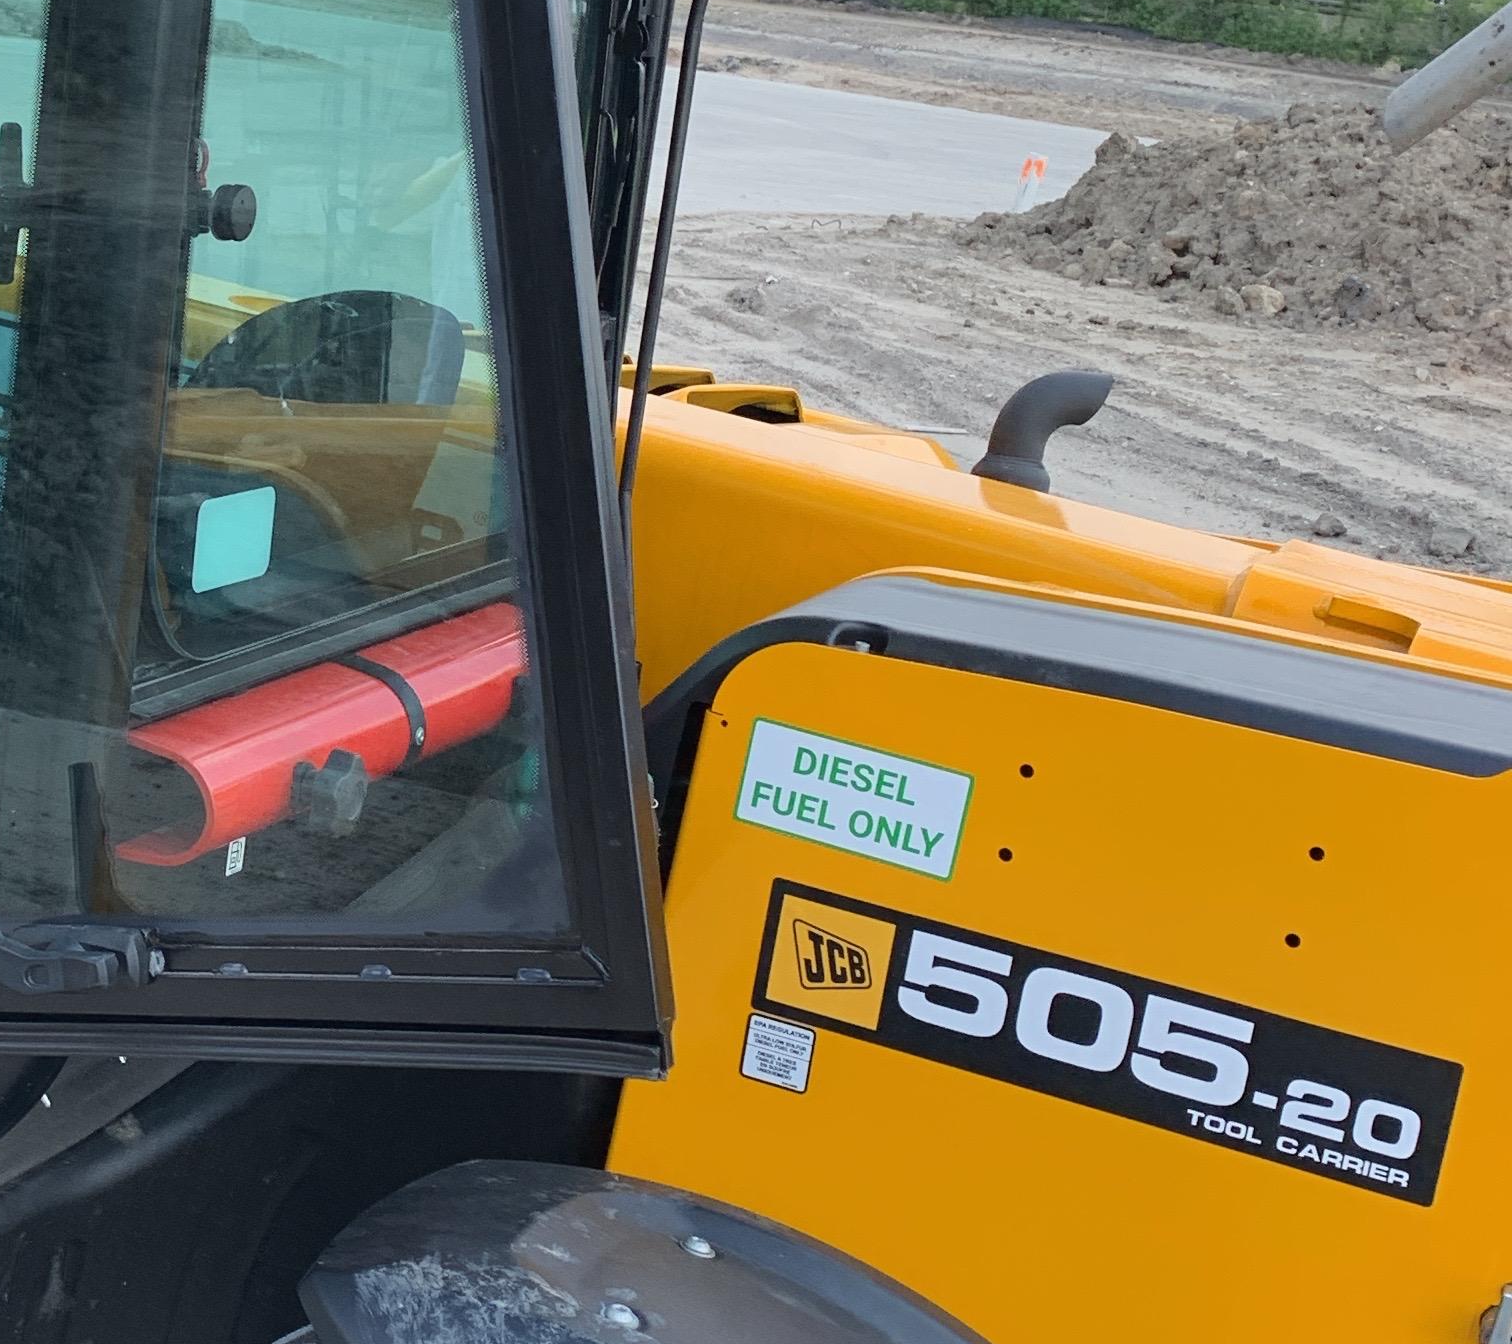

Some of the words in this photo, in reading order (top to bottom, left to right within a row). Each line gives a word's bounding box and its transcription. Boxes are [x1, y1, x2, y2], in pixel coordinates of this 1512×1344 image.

[793, 746, 916, 806] DIESEL
[750, 781, 836, 831] FUEL
[848, 810, 945, 859] ONLY
[803, 931, 867, 987] JCB
[754, 1019, 766, 1027] EPA
[768, 1024, 810, 1040] REGULATION
[1186, 1108, 1263, 1145] TOOL
[1275, 1135, 1410, 1188] CARRIER
